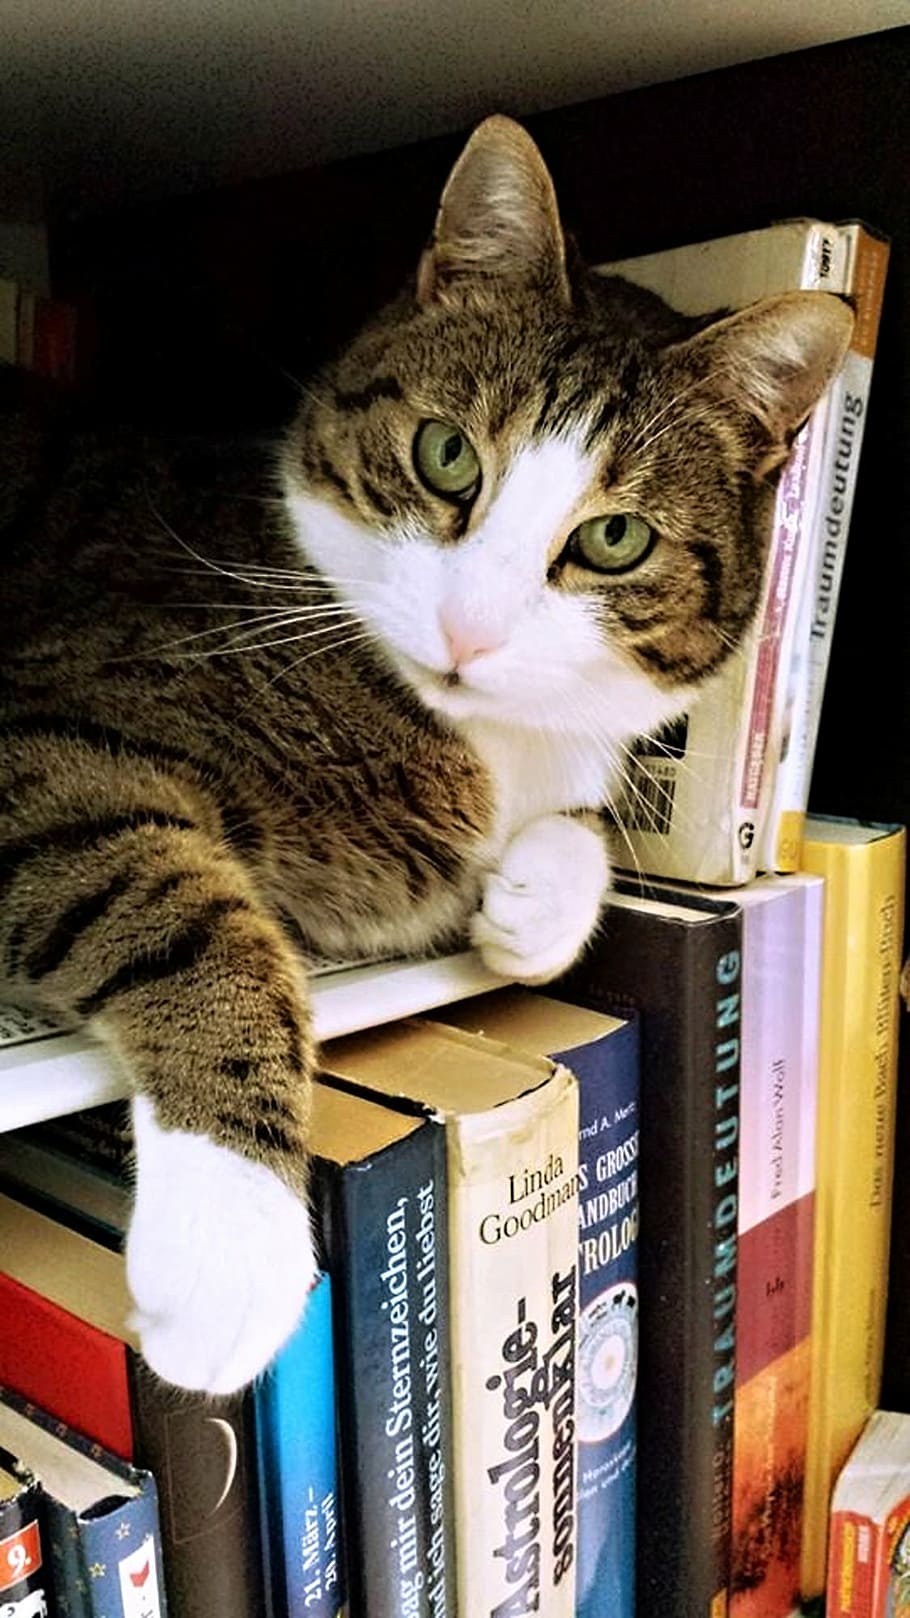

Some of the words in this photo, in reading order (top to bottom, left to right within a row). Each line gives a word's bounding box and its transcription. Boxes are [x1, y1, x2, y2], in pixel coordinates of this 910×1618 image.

[810, 392, 864, 641] Traumdeutung
[772, 1058, 785, 1107] Wolf
[873, 1040, 889, 1099] Bach
[771, 1107, 783, 1151] Alan
[875, 1102, 886, 1157] neue
[508, 1153, 564, 1204] Linda
[712, 950, 741, 1428] TRAUMDEUTUNG
[770, 1154, 783, 1199] Fred
[415, 1178, 436, 1282] liebst
[479, 1173, 581, 1245] Goodman
[380, 1197, 413, 1437] Sternzeichen,
[418, 1278, 437, 1326] du
[419, 1328, 438, 1395] wie
[543, 1265, 576, 1587] sonnenklar
[387, 1433, 416, 1511] dein
[429, 1449, 446, 1525] sage
[486, 1296, 547, 1618] Astrologie-
[320, 1492, 337, 1551] April
[390, 1514, 417, 1574] mir
[427, 1524, 445, 1584] ich
[303, 1569, 322, 1607] 21.
